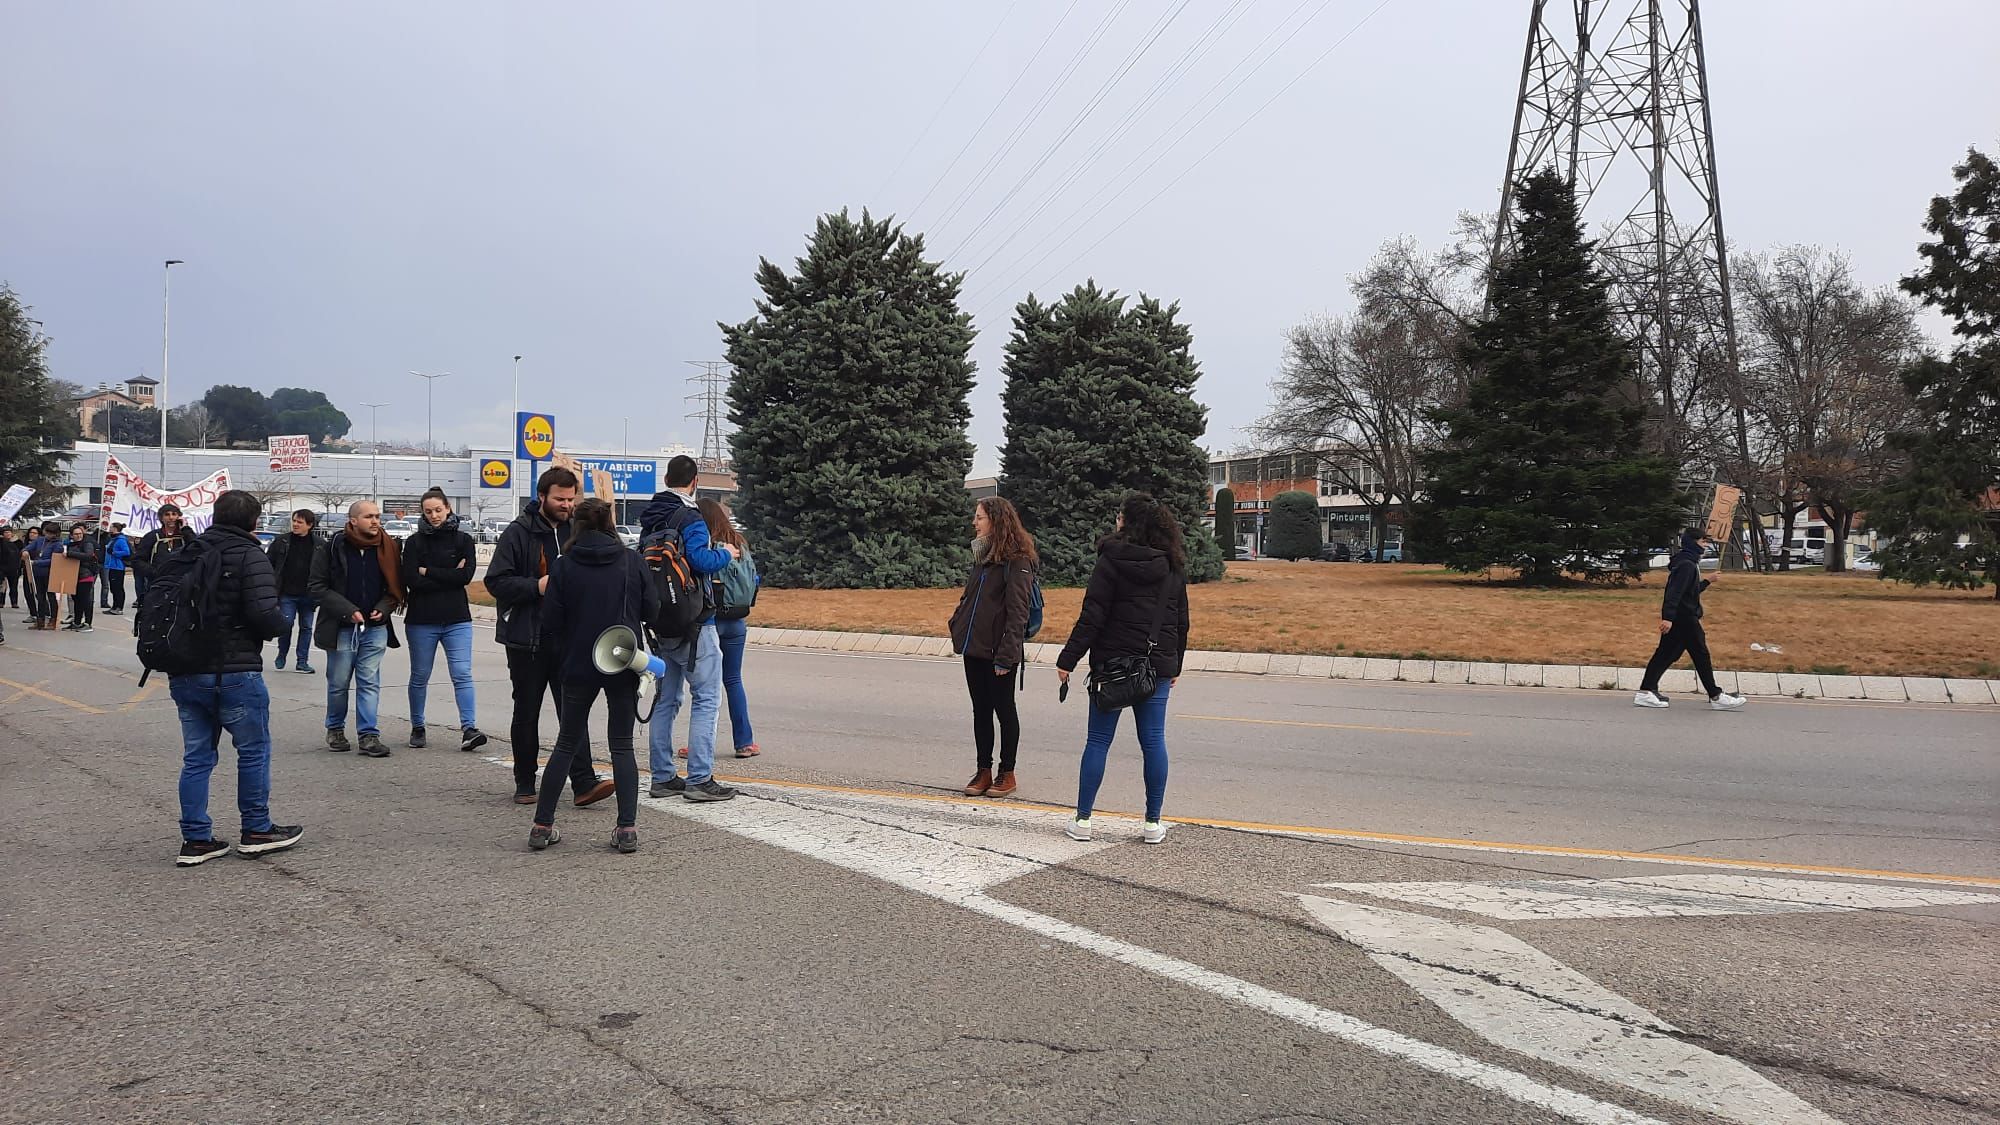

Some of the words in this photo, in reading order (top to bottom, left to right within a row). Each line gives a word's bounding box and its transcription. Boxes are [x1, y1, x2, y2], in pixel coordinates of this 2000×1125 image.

[524, 428, 552, 443] LIDL
[609, 463, 653, 472] ABIERTO
[1330, 513, 1371, 522] Pintures
